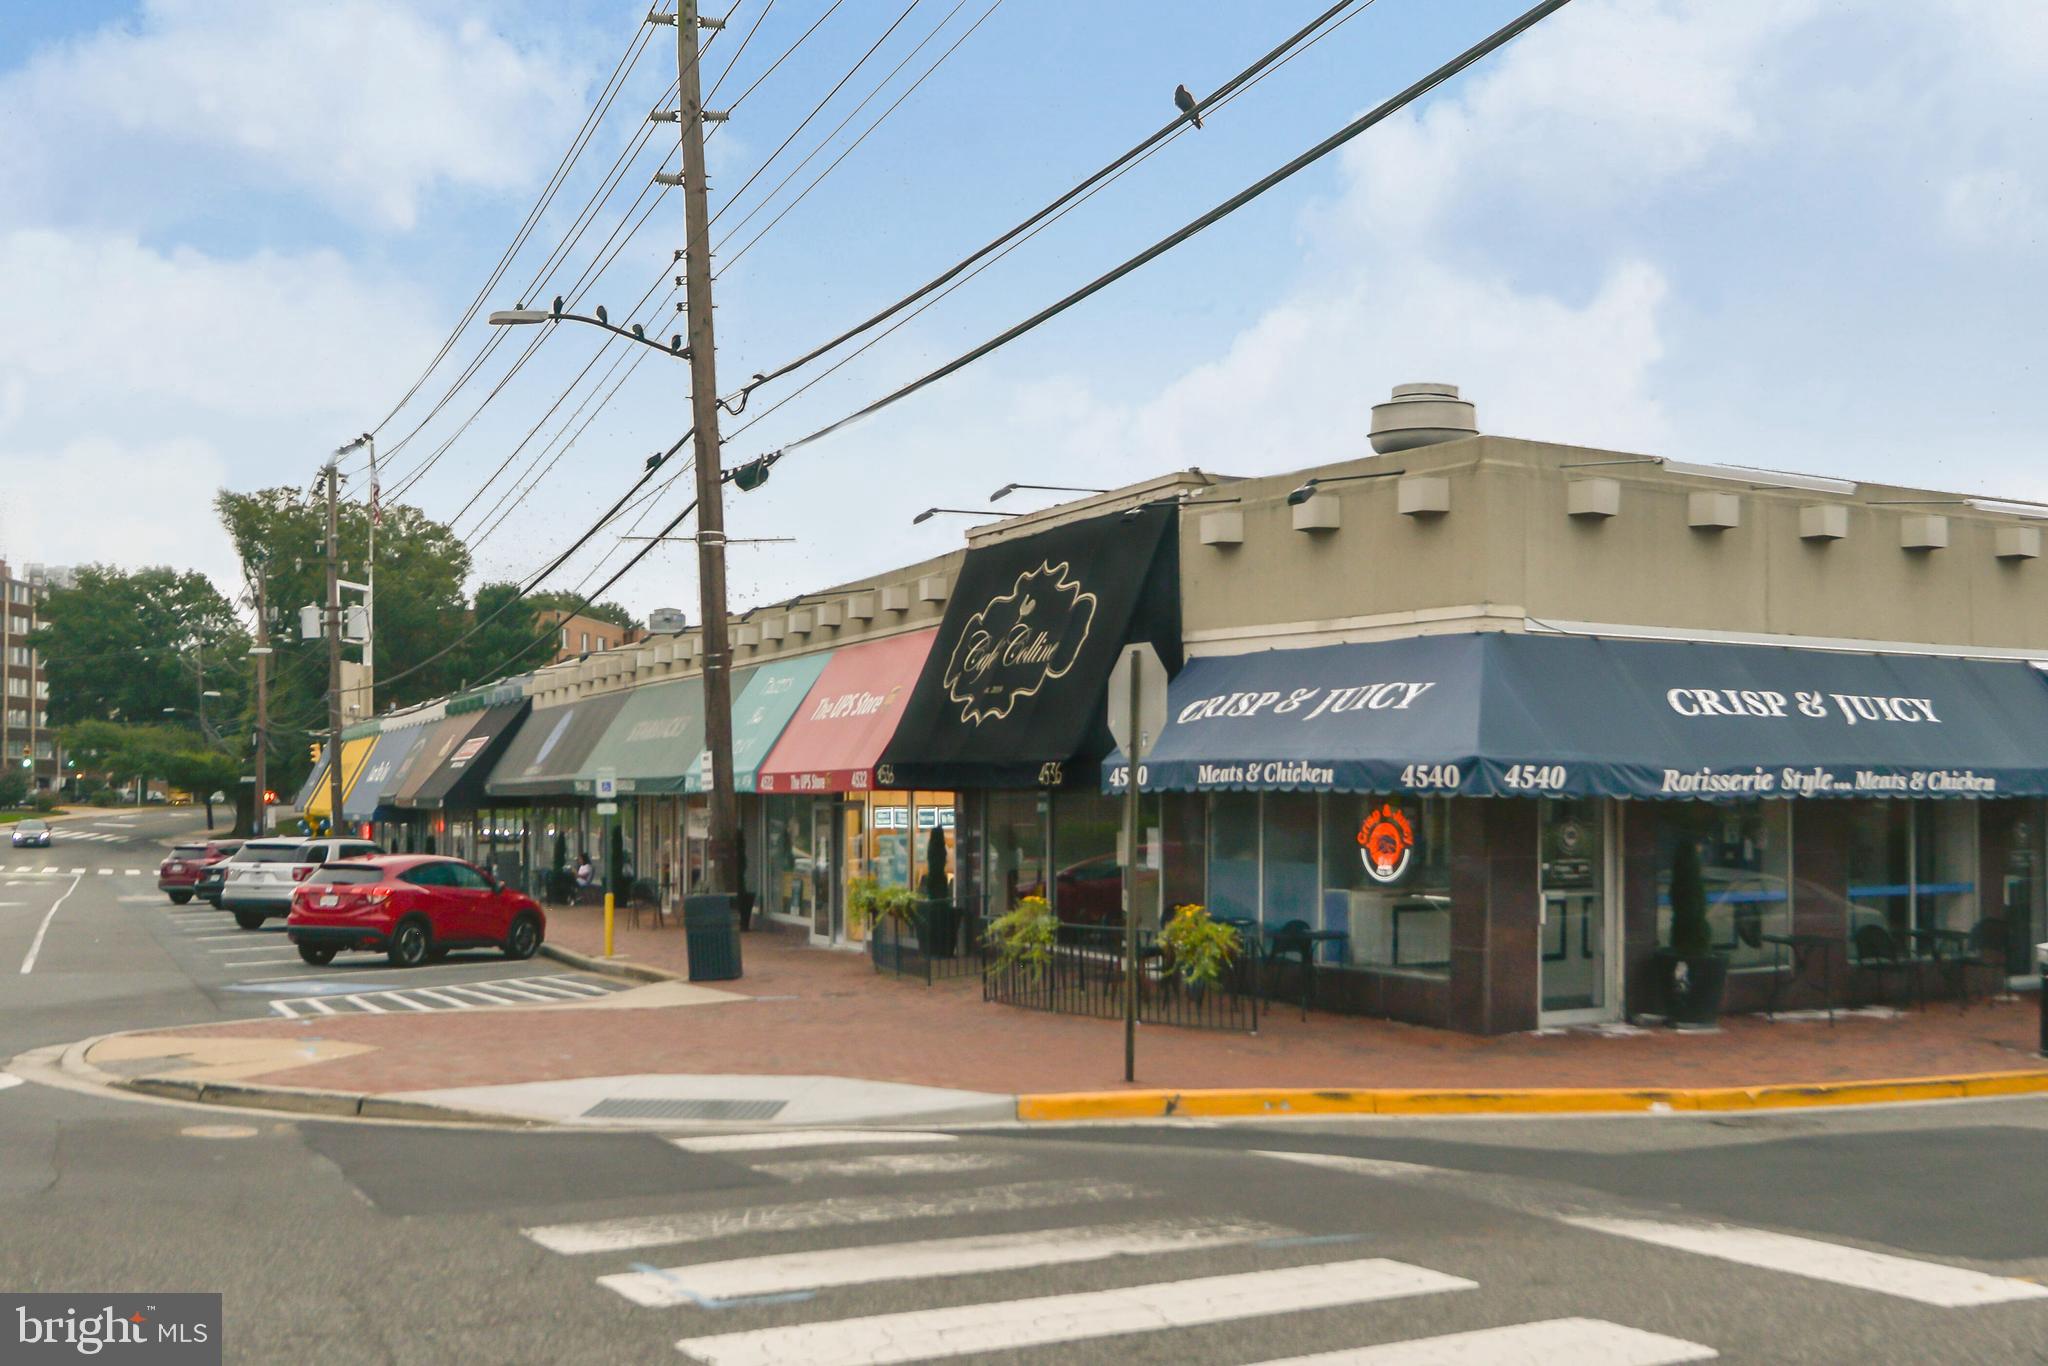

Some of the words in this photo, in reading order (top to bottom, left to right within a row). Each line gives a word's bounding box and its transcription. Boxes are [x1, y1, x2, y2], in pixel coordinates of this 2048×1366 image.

[810, 697, 835, 721] The
[831, 693, 857, 718] UPS
[852, 691, 885, 717] Store
[1177, 689, 1279, 724] CRISP
[1275, 687, 1320, 714] &
[1303, 682, 1436, 720] JUICY
[1666, 688, 1787, 718] CRISP
[1794, 690, 1828, 718] &
[1829, 693, 1943, 726] JUICY
[1038, 762, 1062, 785] 4536
[1108, 765, 1148, 787] 450
[1197, 765, 1243, 784] Meats
[1246, 763, 1263, 783] &
[1263, 760, 1335, 784] Chicken
[1400, 764, 1460, 788] 4540
[1504, 764, 1567, 789] 4540
[1662, 766, 1773, 792] Rotisserie
[1855, 770, 1906, 791] Meats
[1909, 771, 1926, 791] &
[1927, 770, 1996, 792] Chicken
